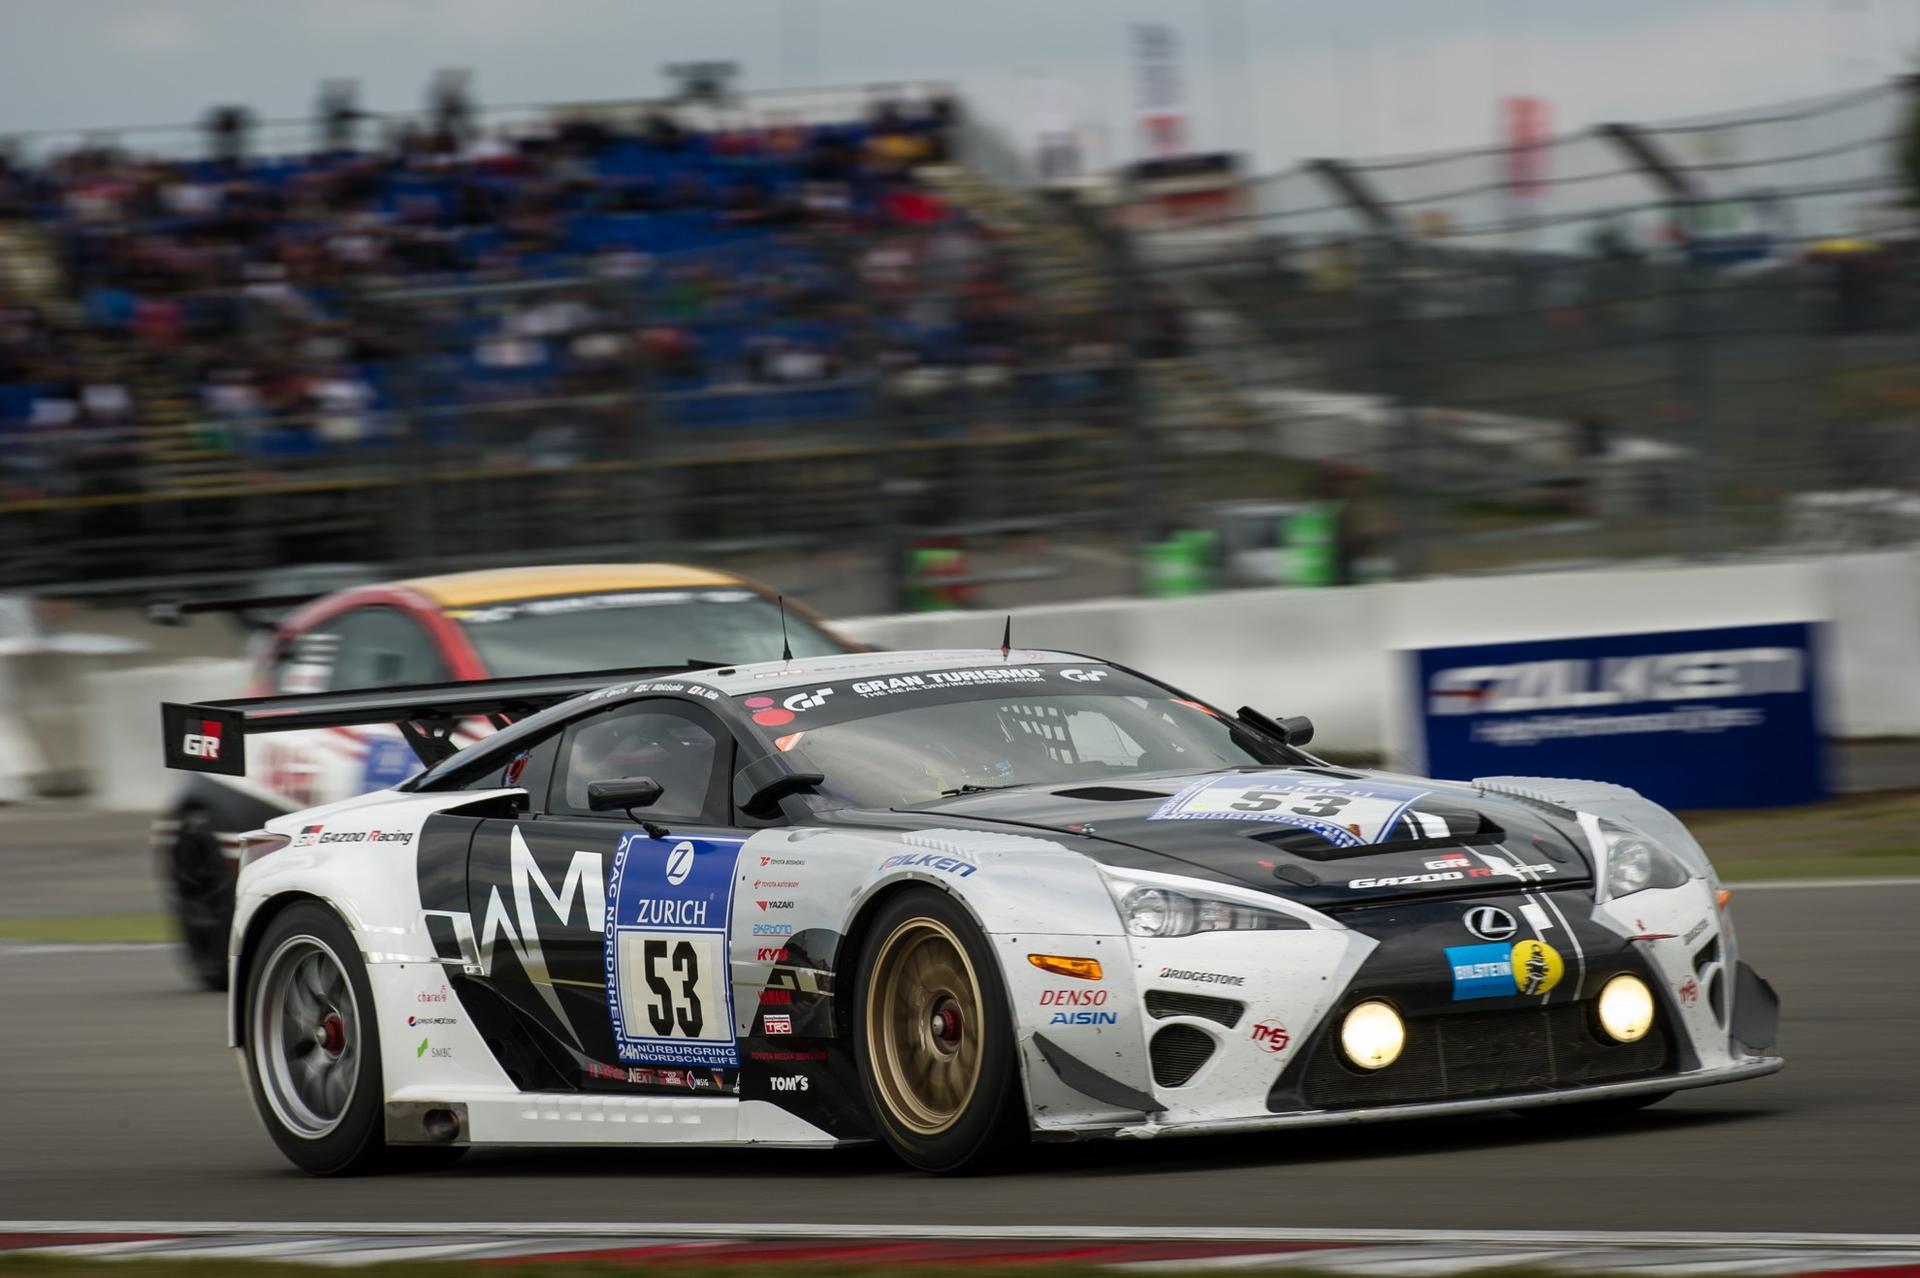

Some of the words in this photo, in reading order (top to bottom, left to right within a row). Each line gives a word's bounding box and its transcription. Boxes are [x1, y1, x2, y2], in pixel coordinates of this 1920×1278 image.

[852, 675, 925, 694] GRAN
[926, 668, 1041, 684] TURISMO
[860, 690, 887, 699] THE
[887, 685, 922, 695] REAL
[183, 733, 220, 758] GR
[1230, 791, 1353, 818] 53
[367, 829, 414, 846] Racing
[607, 835, 629, 898] ADAC
[878, 853, 978, 878] FALKEN
[1424, 858, 1472, 871] GR
[1348, 871, 1465, 889] GAZOO
[636, 899, 708, 925] ZURICH
[769, 901, 794, 909] YAZAKI
[605, 906, 624, 1041] NORDRHEIN
[1159, 967, 1246, 987] BRIDGESTONE
[643, 939, 704, 1038] 53
[1039, 989, 1108, 1006] DENSO
[1049, 1011, 1118, 1025] AISIN
[617, 1043, 640, 1060] 24h
[638, 1043, 737, 1056] NÜRBURGRING
[639, 1053, 738, 1065] NORDSCHLEIFE
[770, 1074, 809, 1092] TOM'S
